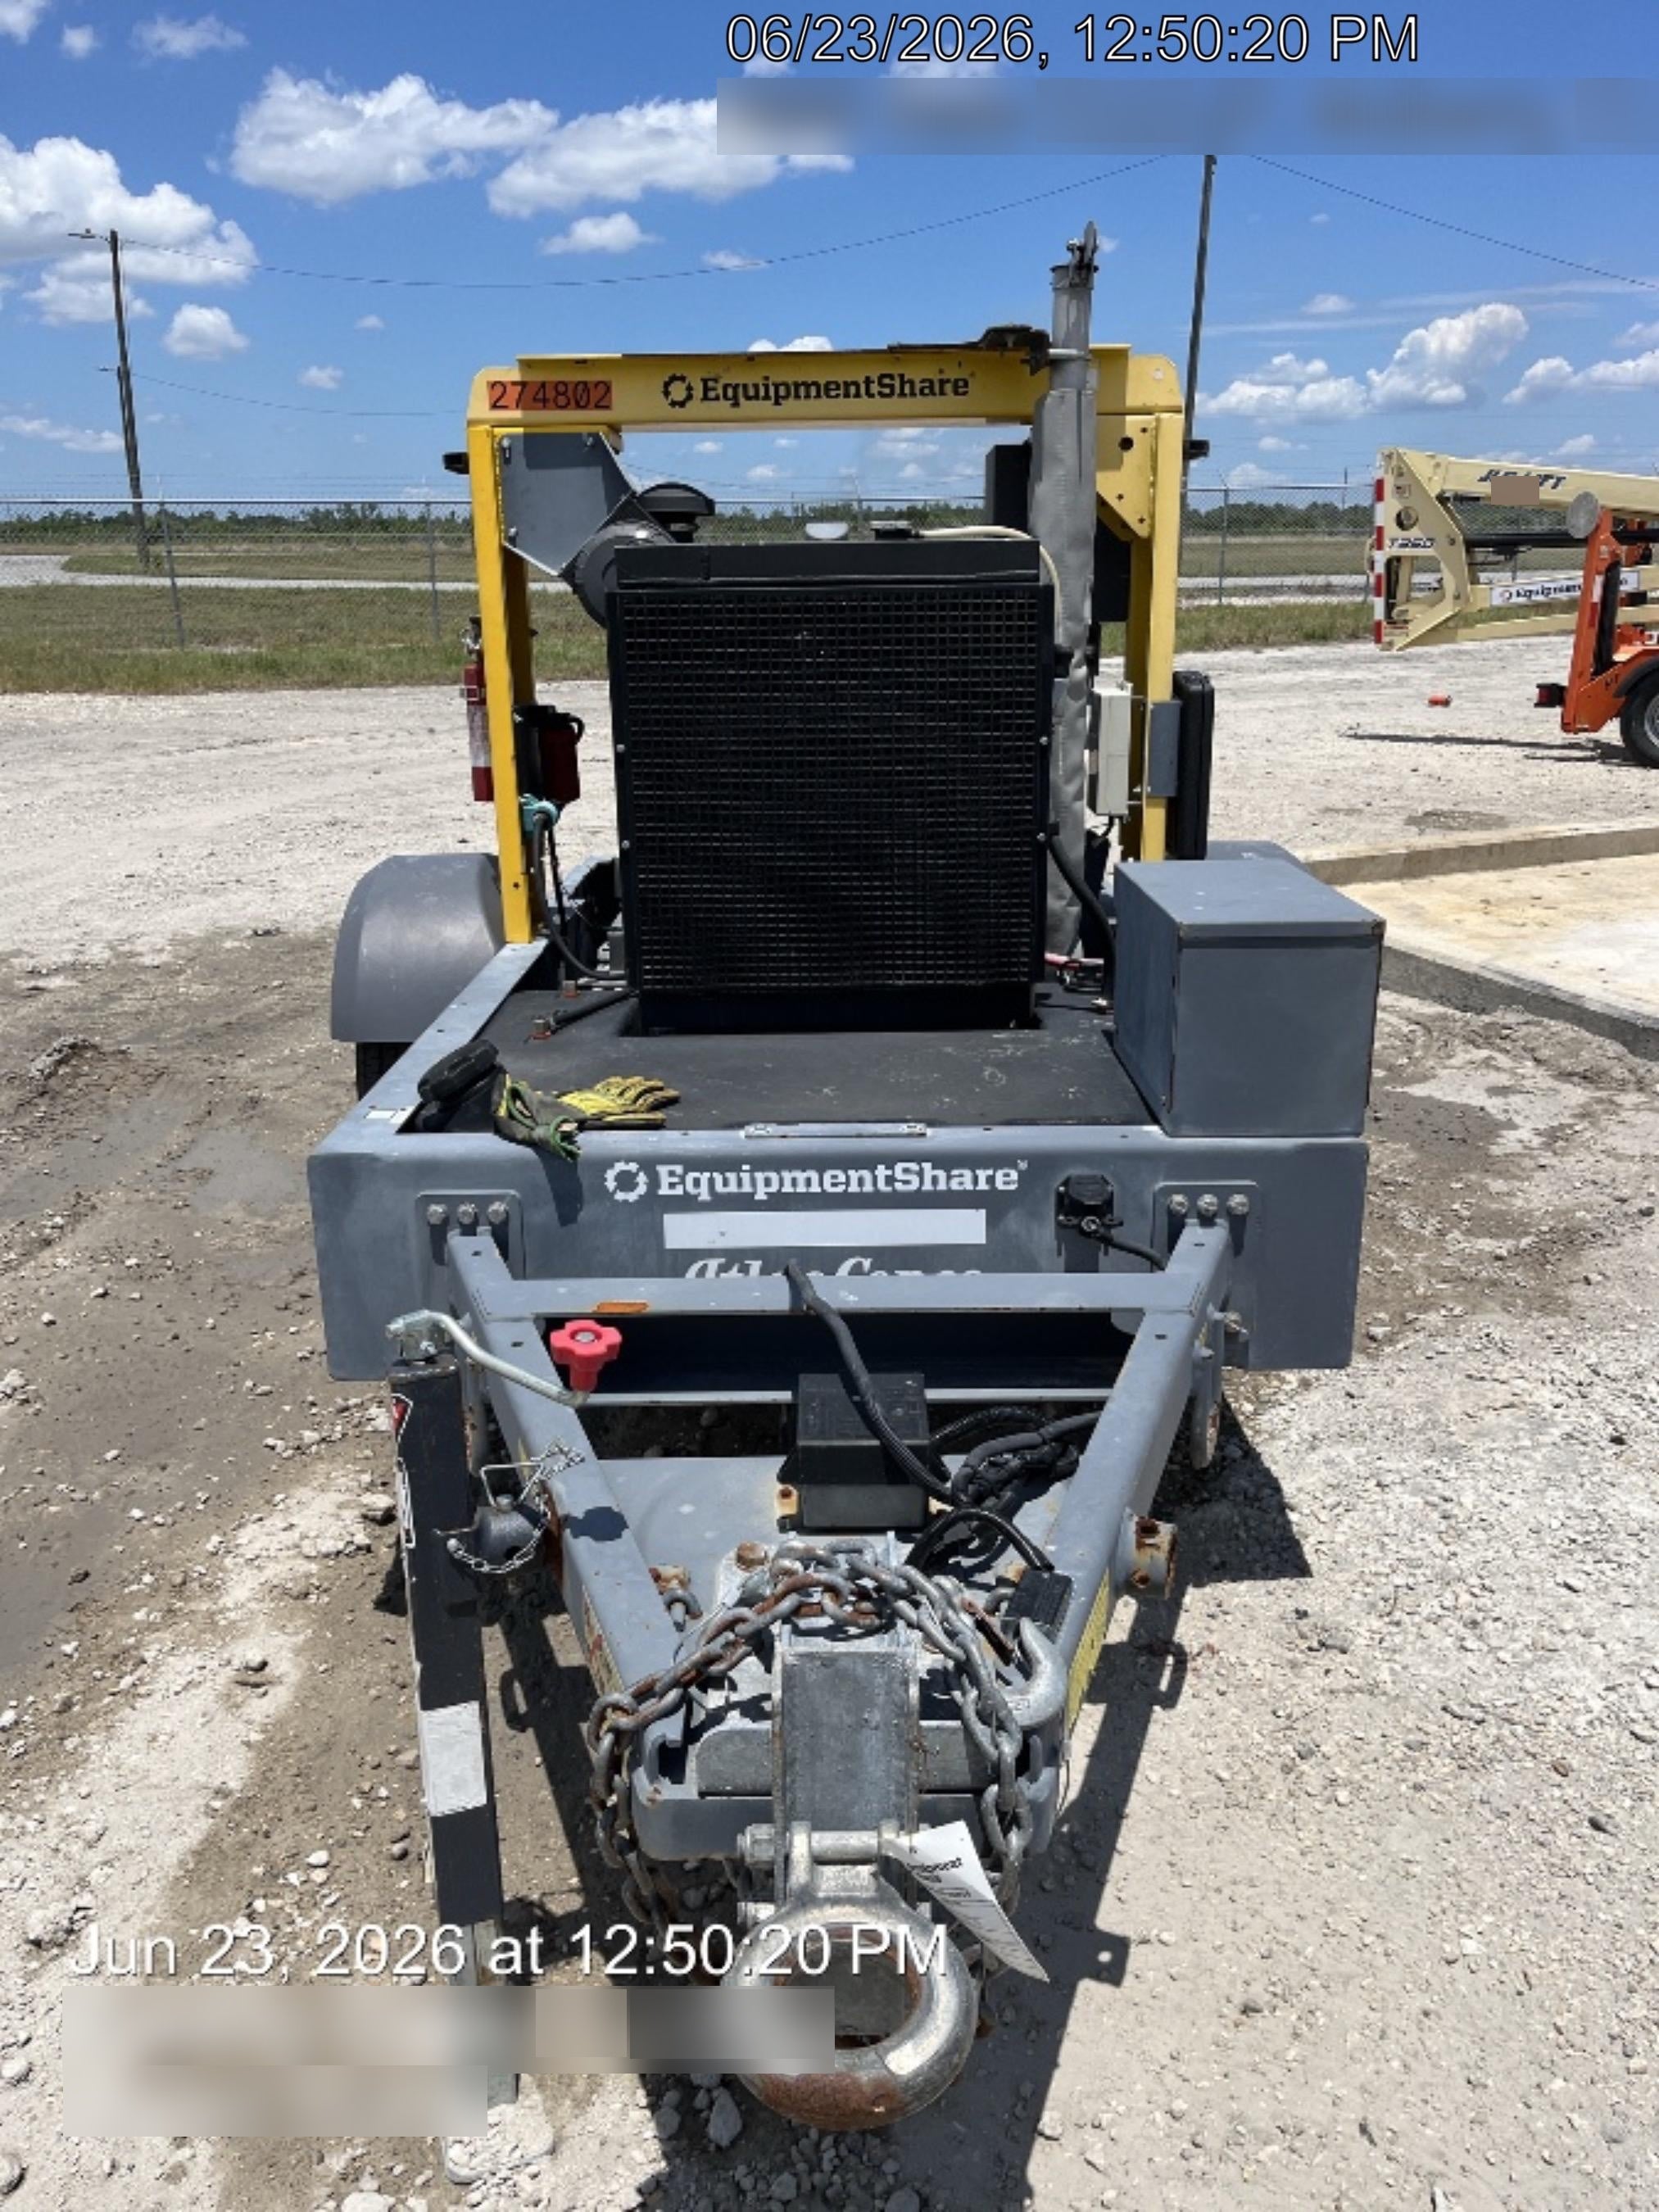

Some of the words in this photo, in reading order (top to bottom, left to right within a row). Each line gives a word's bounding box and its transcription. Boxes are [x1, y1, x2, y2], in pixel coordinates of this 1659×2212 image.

[491, 381, 612, 410] 274802
[699, 373, 970, 407] EquipmentShare
[656, 1162, 1019, 1200] EquipmentShare
